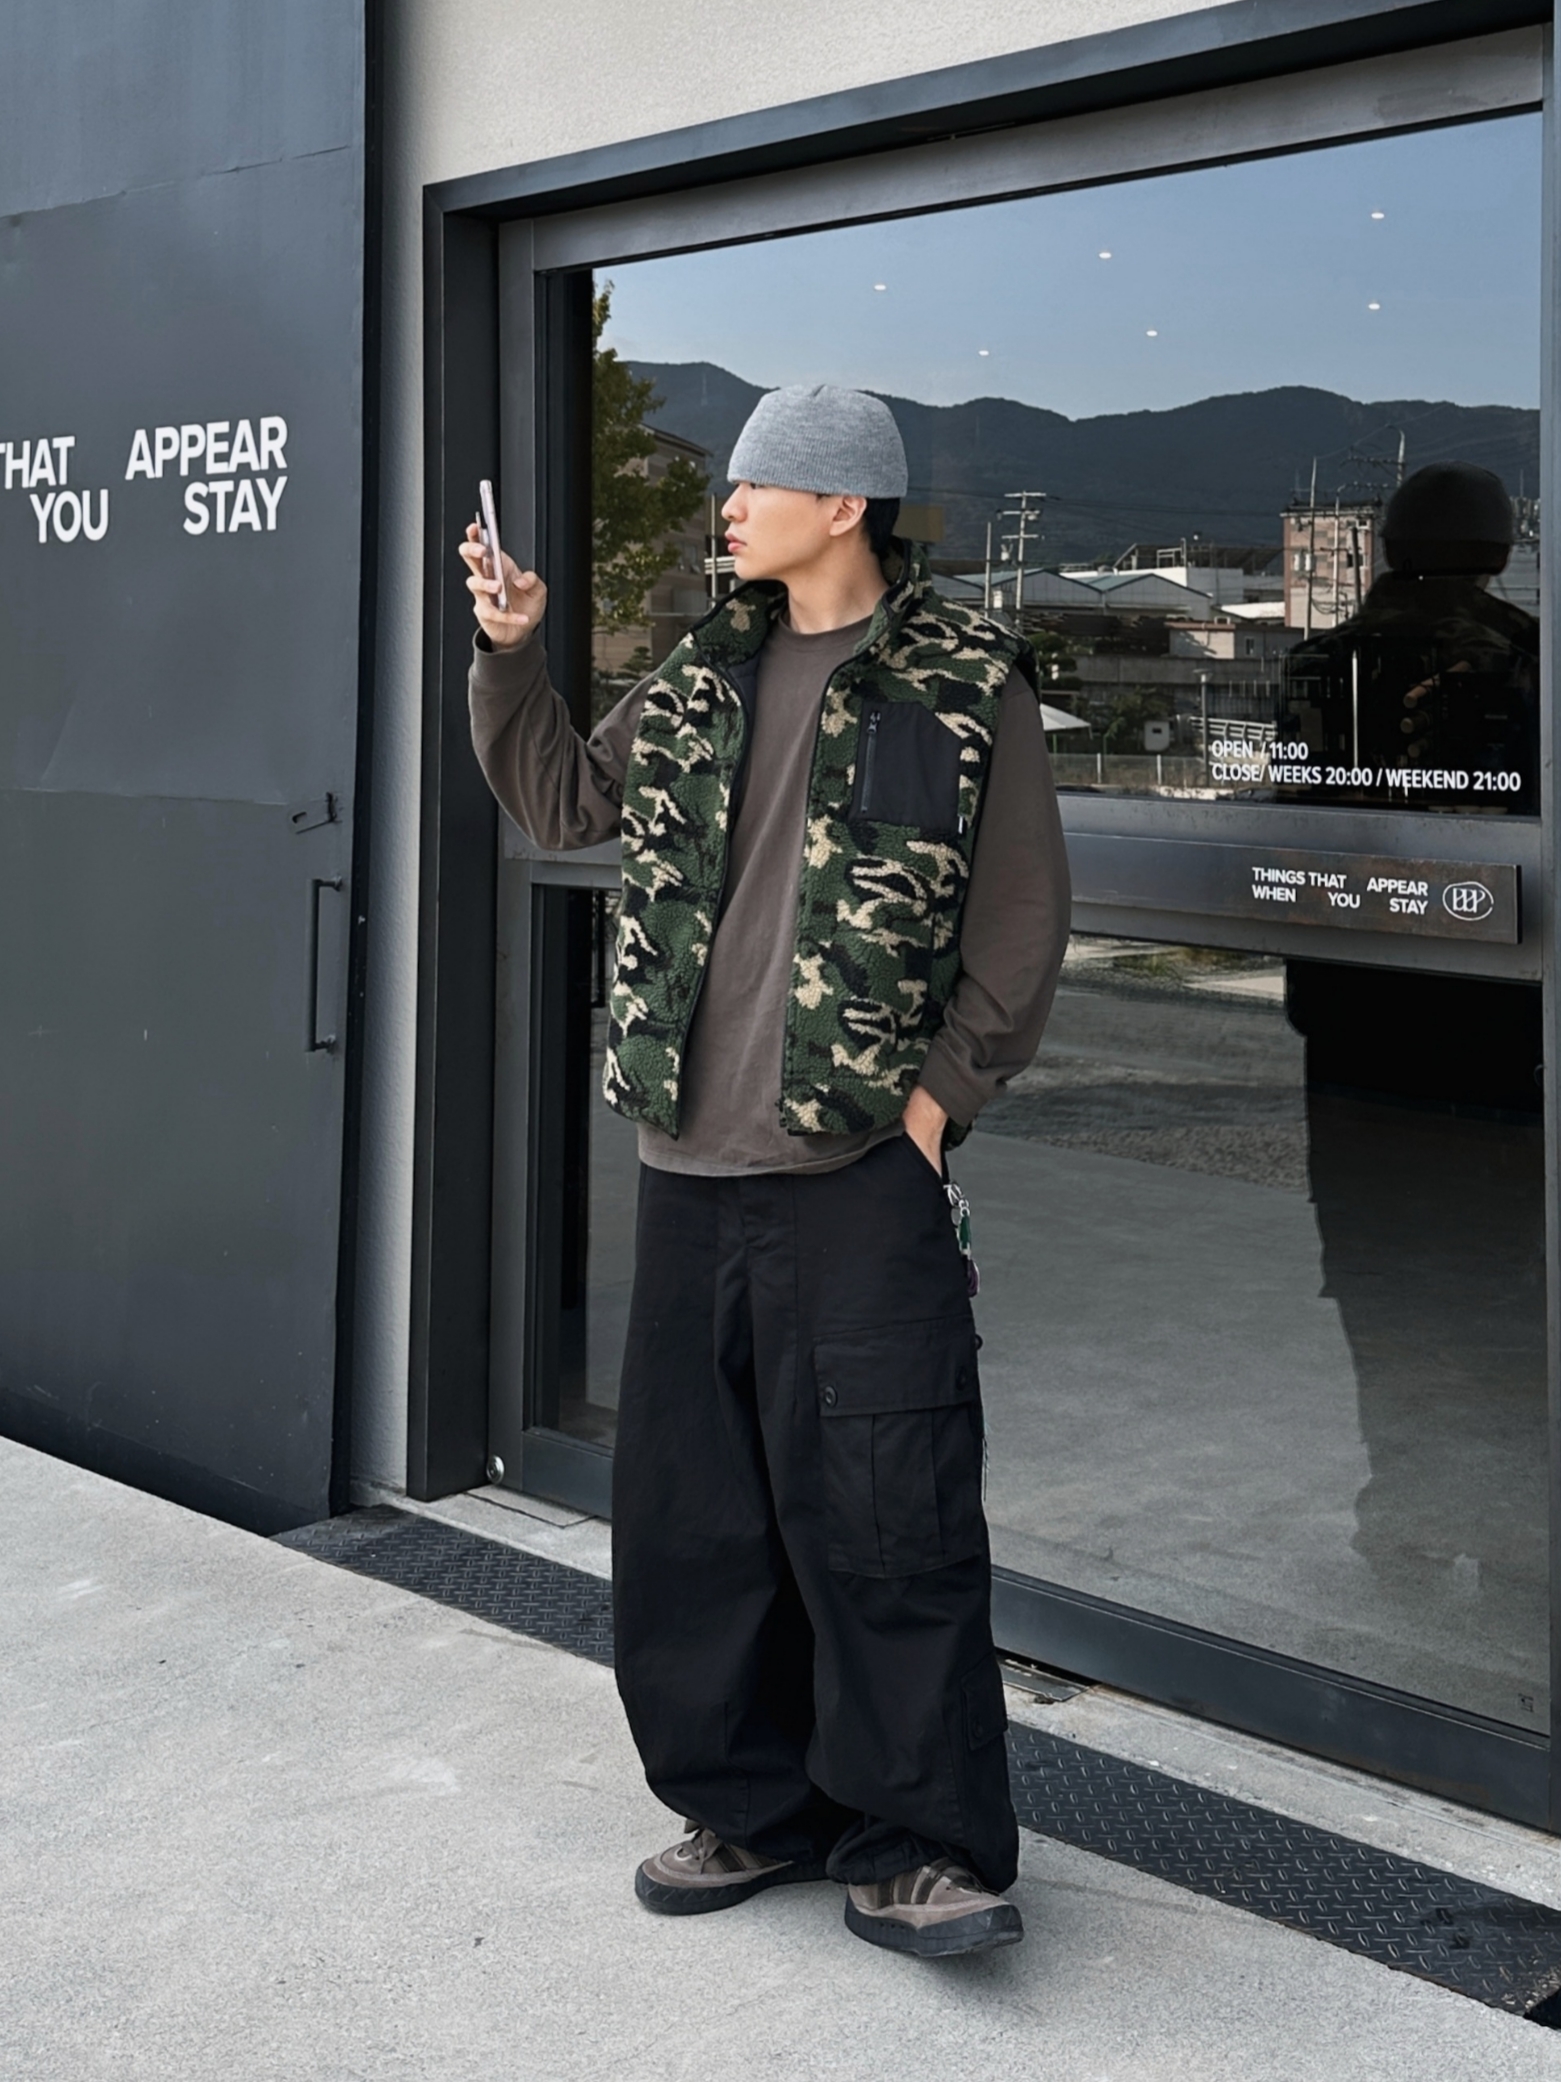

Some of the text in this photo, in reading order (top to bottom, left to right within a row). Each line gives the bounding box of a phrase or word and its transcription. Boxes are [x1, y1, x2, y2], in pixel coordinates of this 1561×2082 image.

[0, 416, 287, 490] HAT APPEAR
[29, 476, 288, 543] YOU STAY
[1211, 740, 1253, 758] OPEN
[1269, 742, 1309, 760] 11:00
[1268, 764, 1322, 785] WEEKS
[1325, 766, 1373, 787] 20:00
[1385, 768, 1469, 790] WEEKEND
[1473, 771, 1521, 792] 21:00
[1252, 867, 1428, 896] THINGS THAT APPEAR
[1252, 884, 1428, 915] WHEN YOU STAY
